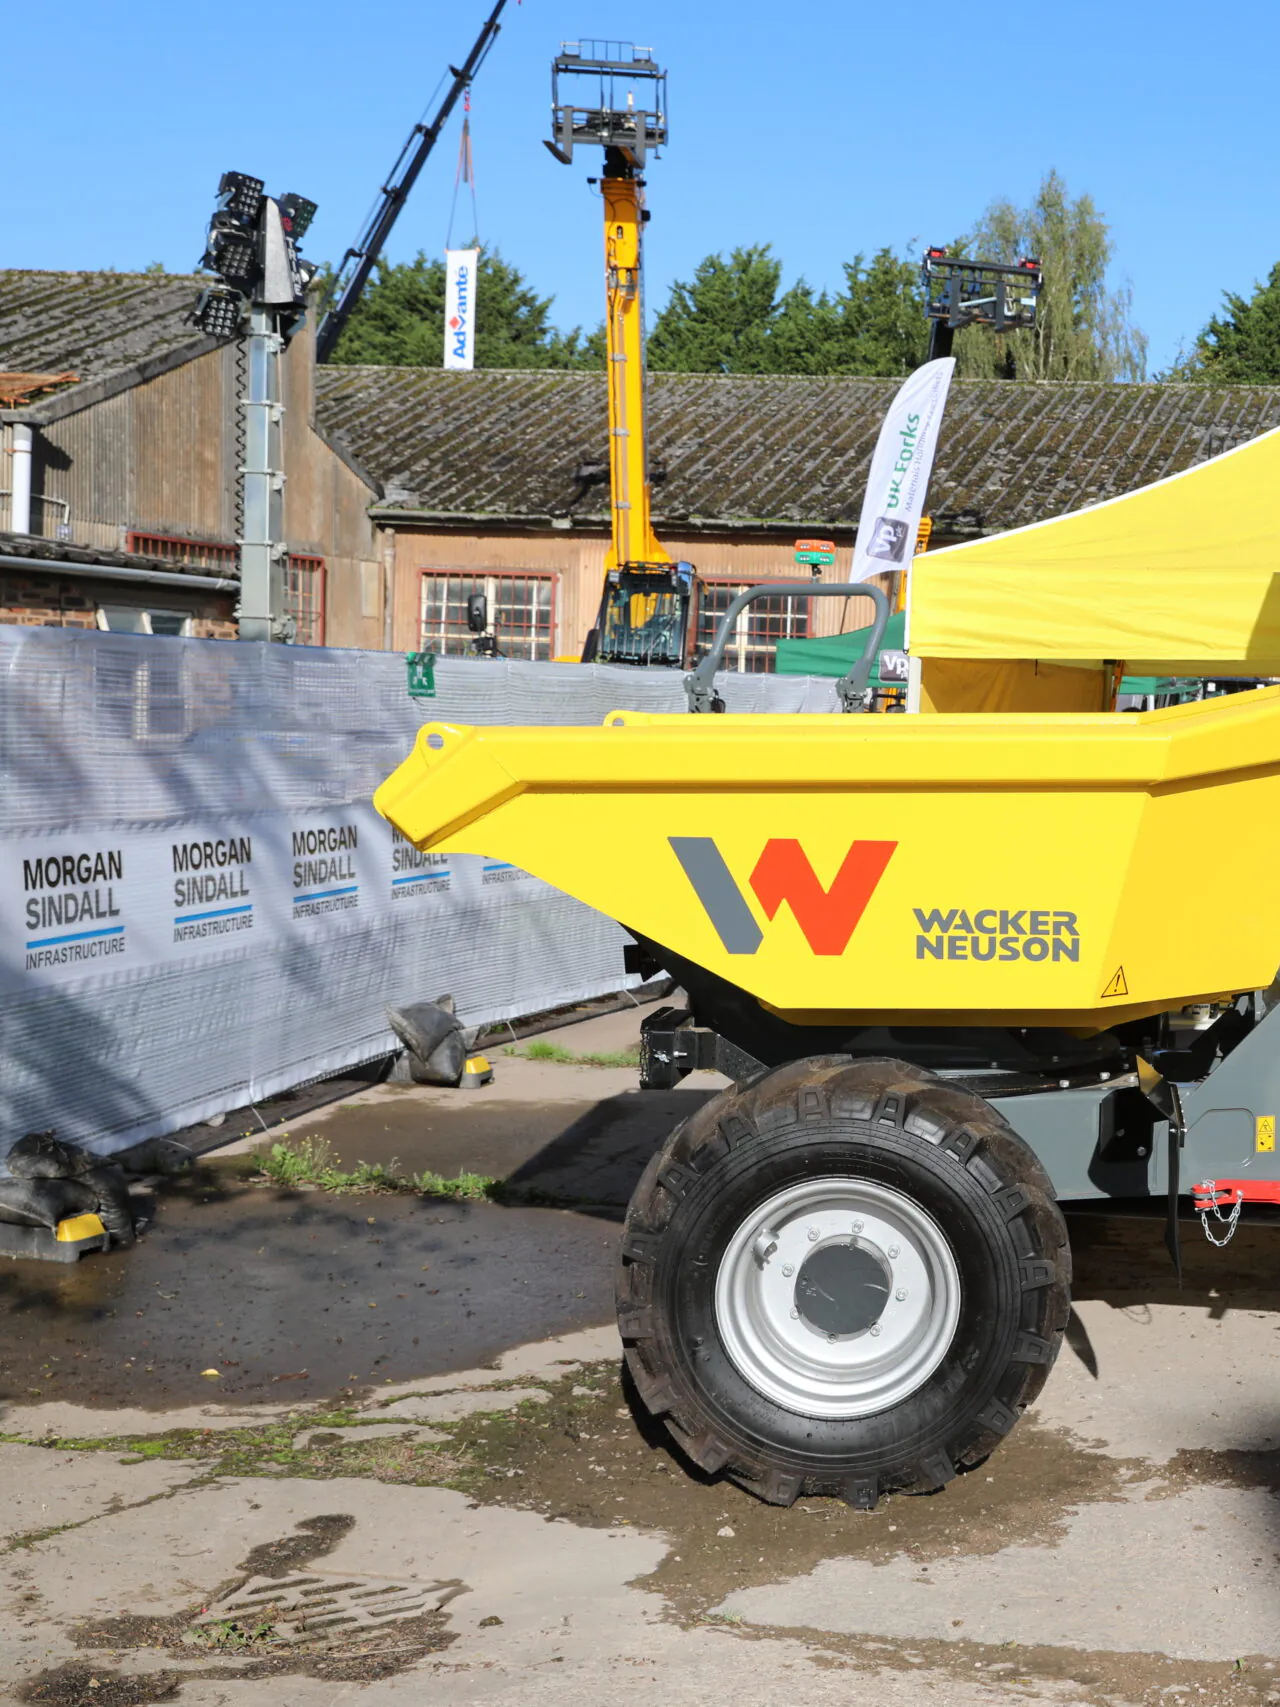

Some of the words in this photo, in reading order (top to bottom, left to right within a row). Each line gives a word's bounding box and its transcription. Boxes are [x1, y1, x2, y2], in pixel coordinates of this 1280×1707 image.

[887, 479, 901, 509] UK
[894, 412, 920, 472] Forks
[172, 837, 251, 873] MORGAN
[292, 825, 358, 857] MORGAN
[23, 850, 122, 891] MORGAN
[293, 855, 356, 888] SINDALL
[392, 848, 448, 872] SINDALL
[174, 870, 249, 907] SINDALL
[392, 878, 450, 900] INFRASTRUCTURE
[25, 887, 120, 930] SINDALL
[293, 894, 359, 919] INFRASTRUCTURE
[912, 908, 1079, 935] WACKER
[174, 914, 253, 943] INFRASTRUCTURE
[26, 937, 125, 970] INFRASTRUCTURE
[915, 935, 1080, 962] NEUSON
